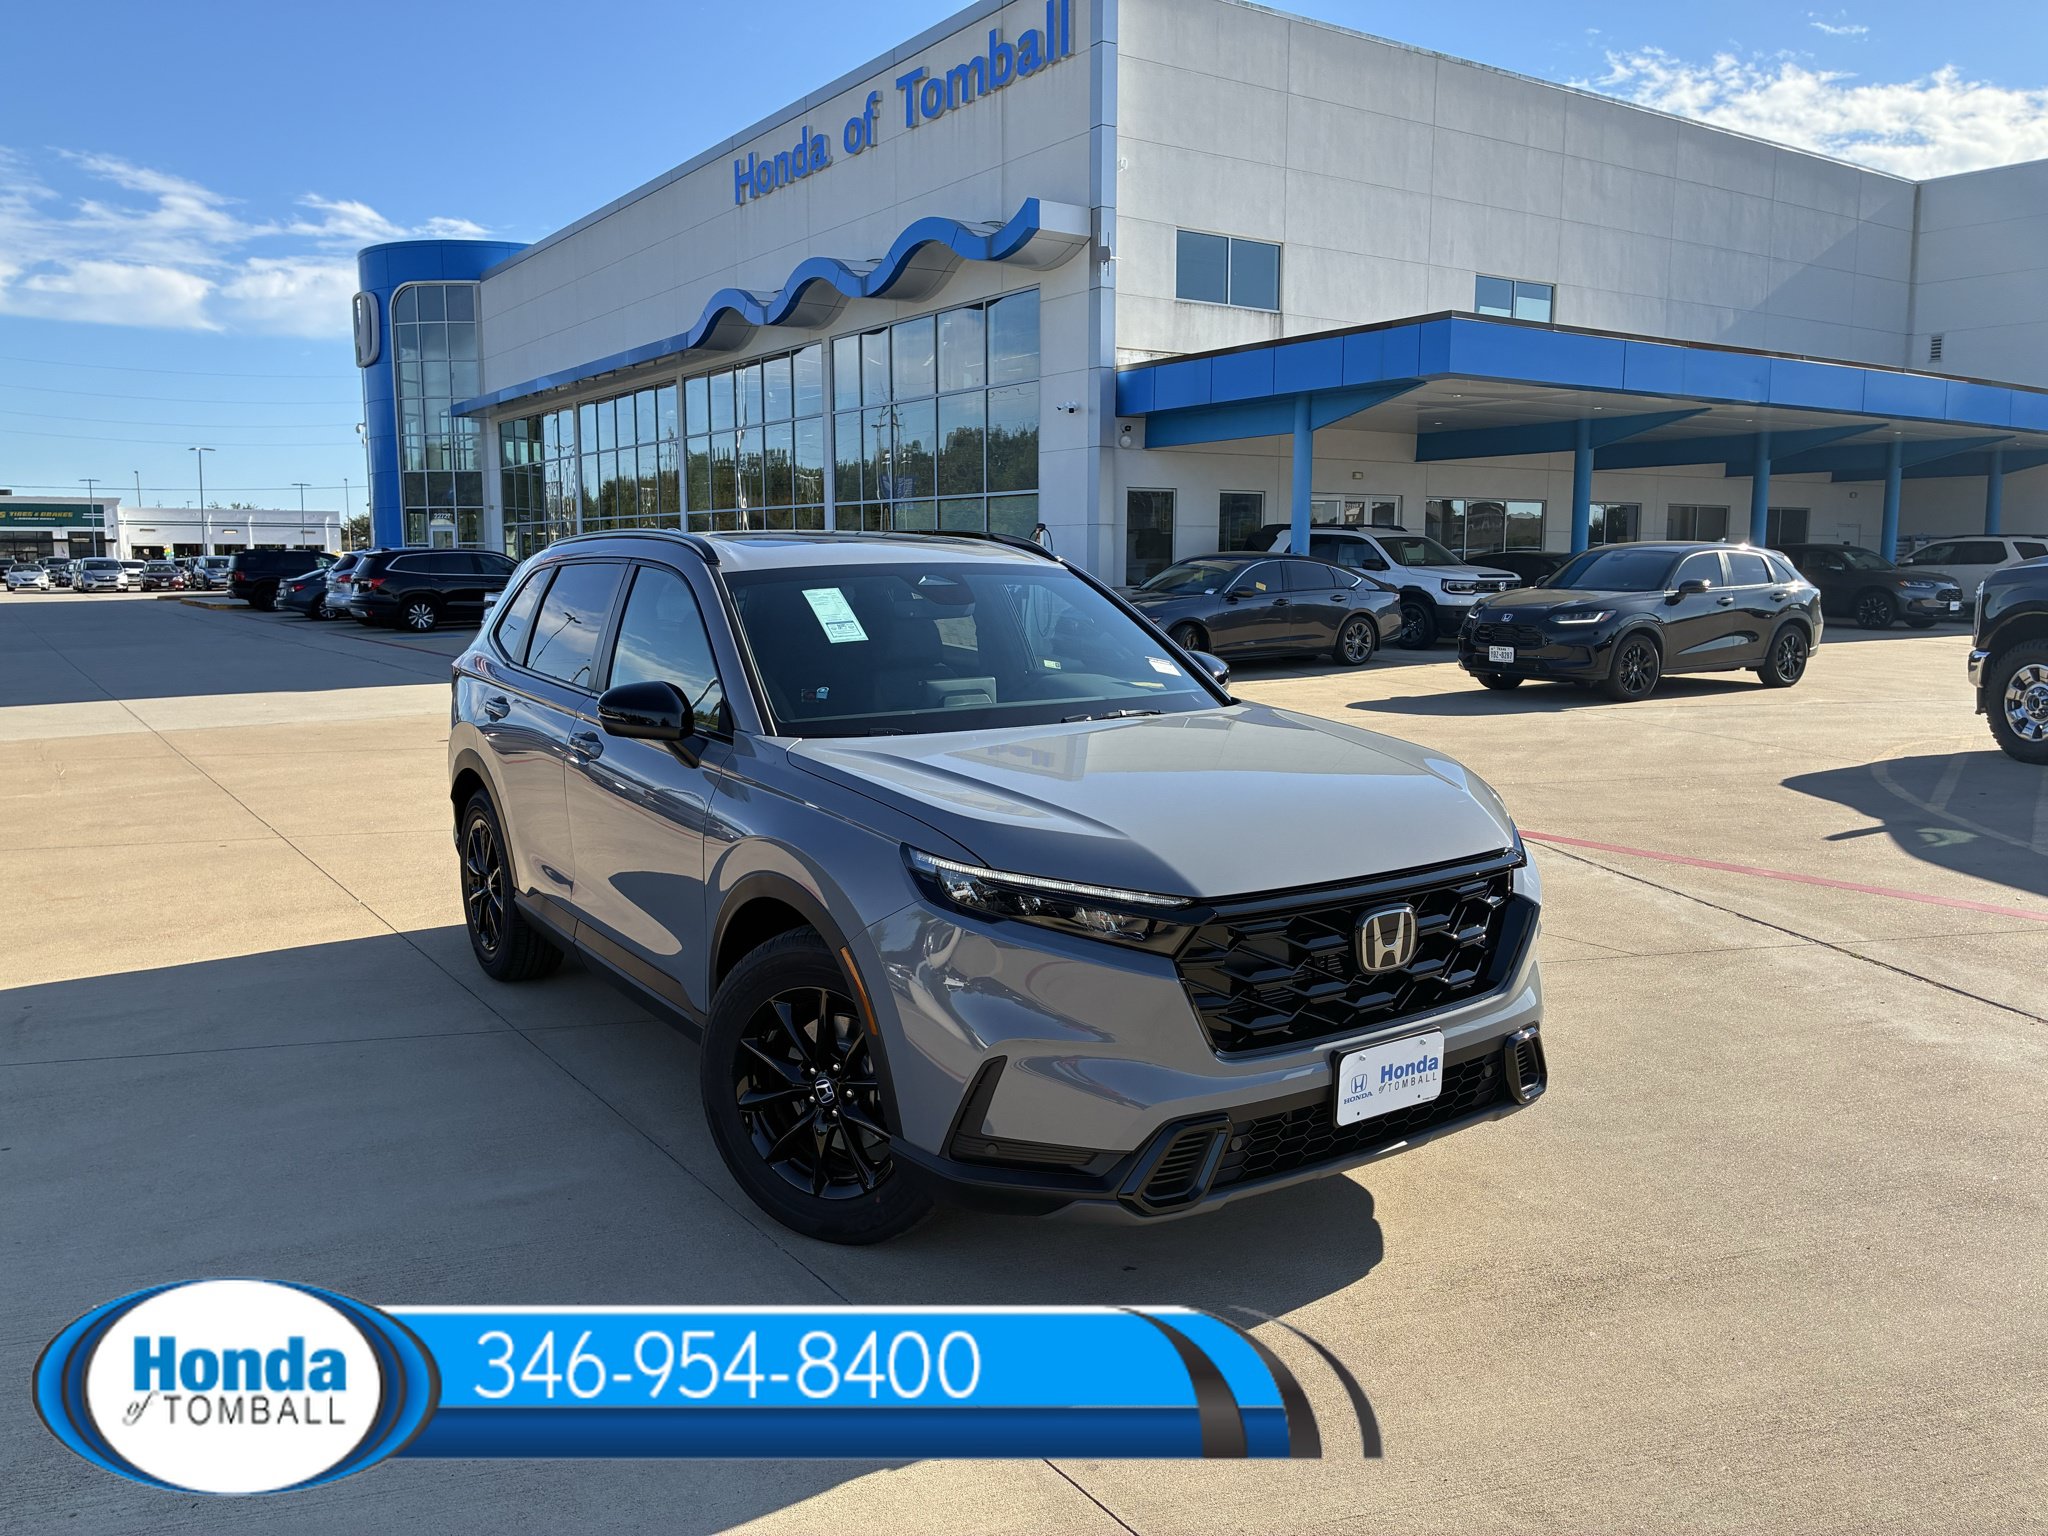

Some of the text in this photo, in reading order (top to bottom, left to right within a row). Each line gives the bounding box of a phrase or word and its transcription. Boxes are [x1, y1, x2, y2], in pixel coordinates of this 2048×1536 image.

[734, 0, 1075, 206] Honda of Tomball
[1380, 1055, 1439, 1083] Honda
[1378, 1072, 1437, 1094] of TOMBALL
[1343, 1091, 1373, 1104] HONDA
